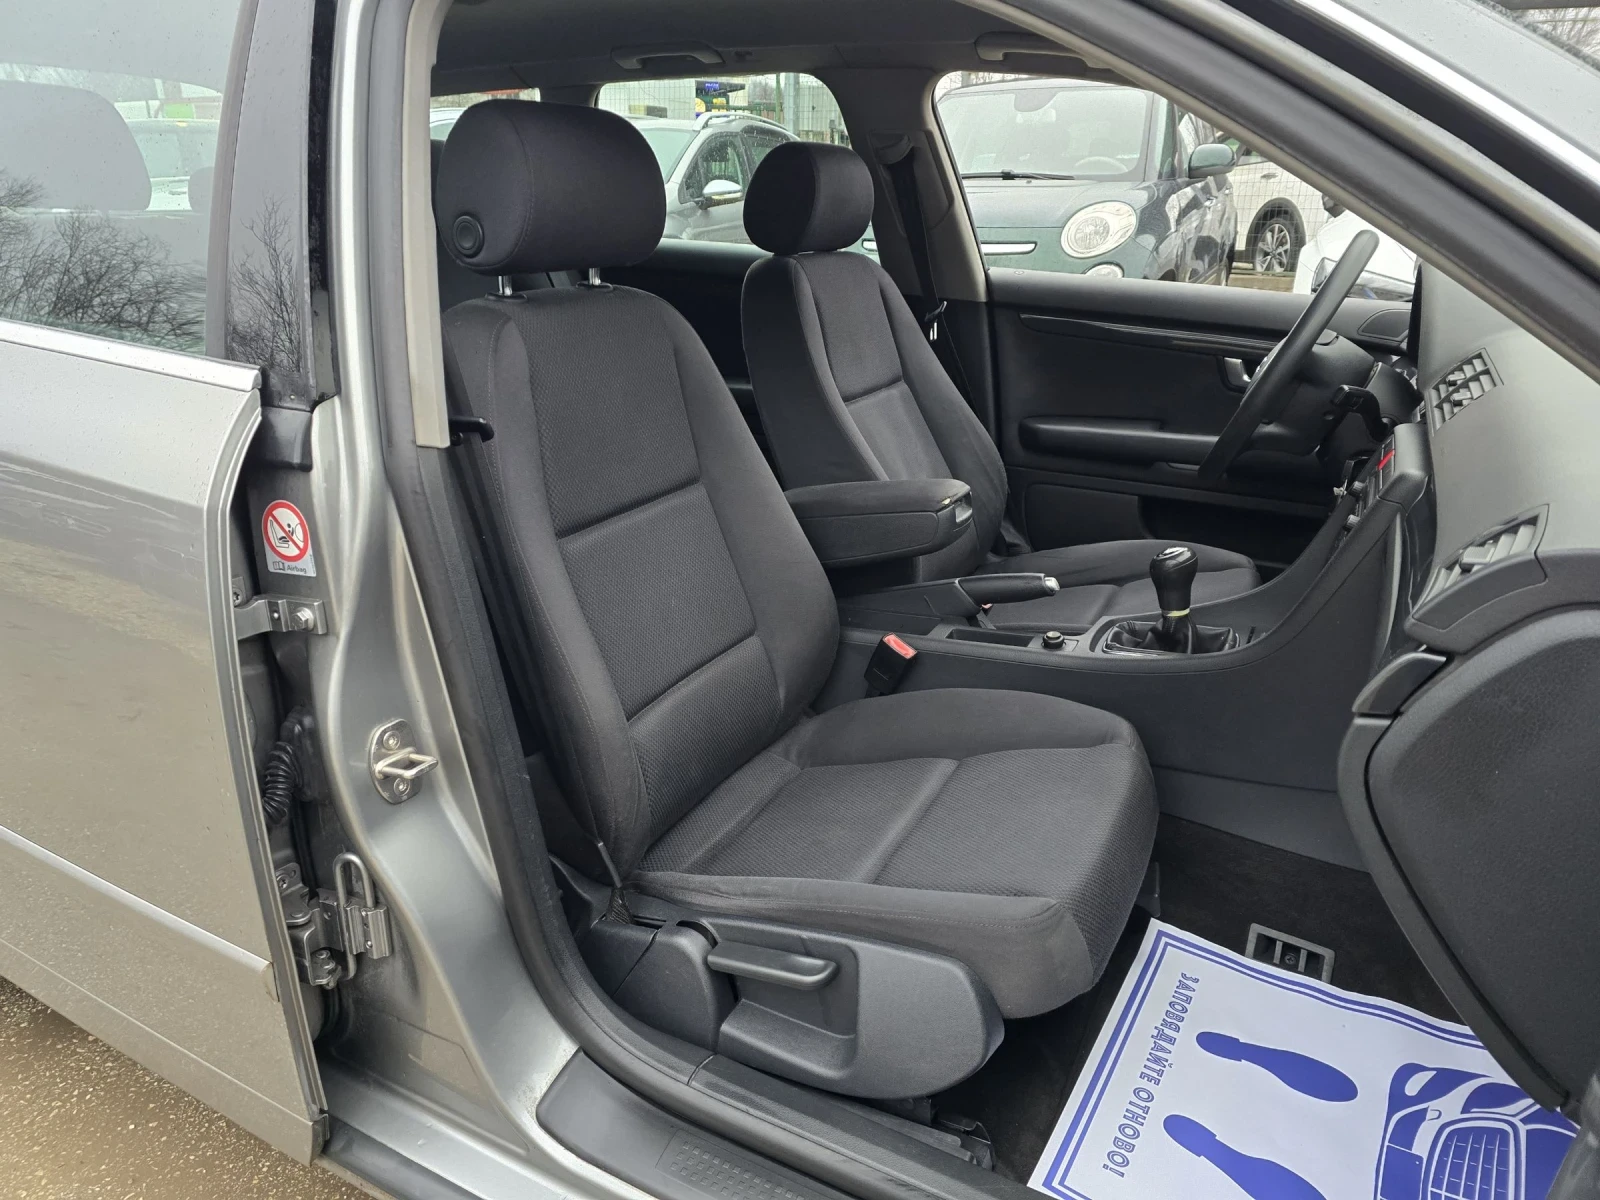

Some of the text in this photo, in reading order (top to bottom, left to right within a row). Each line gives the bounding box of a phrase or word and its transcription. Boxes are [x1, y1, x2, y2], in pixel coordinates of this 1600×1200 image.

[287, 565, 307, 574] Airbag
[1102, 972, 1200, 1178] ЗАПОВЯДАЙТЕ ОТНОВО!
